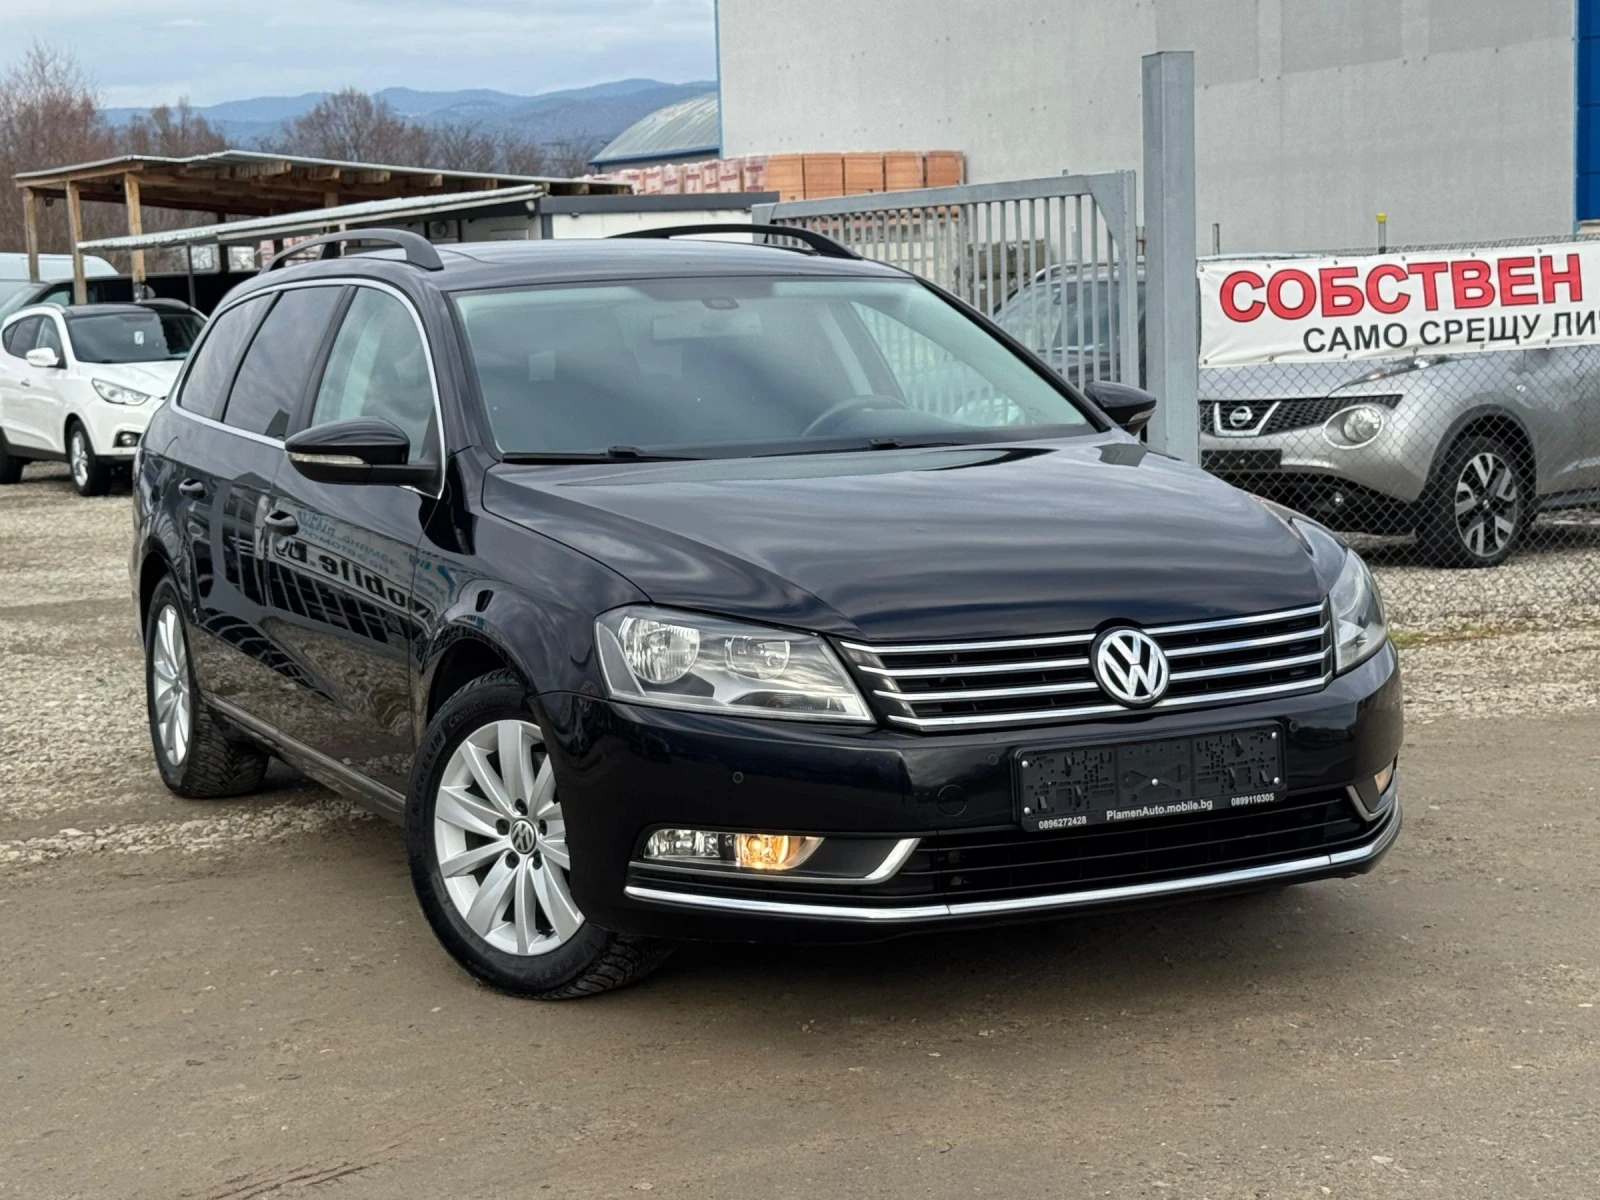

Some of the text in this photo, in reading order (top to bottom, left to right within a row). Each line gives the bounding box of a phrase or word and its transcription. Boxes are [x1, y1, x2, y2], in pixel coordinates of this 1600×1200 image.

[1219, 253, 1582, 322] СОБСТВЕН
[1303, 310, 1600, 353] САМО СРЕЩУ ЛИ
[1098, 629, 1168, 703] VW
[1106, 799, 1213, 821] PlamenAuto.mobile.bg
[1231, 793, 1275, 807] 0899110305
[1038, 816, 1087, 829] 0896272428
